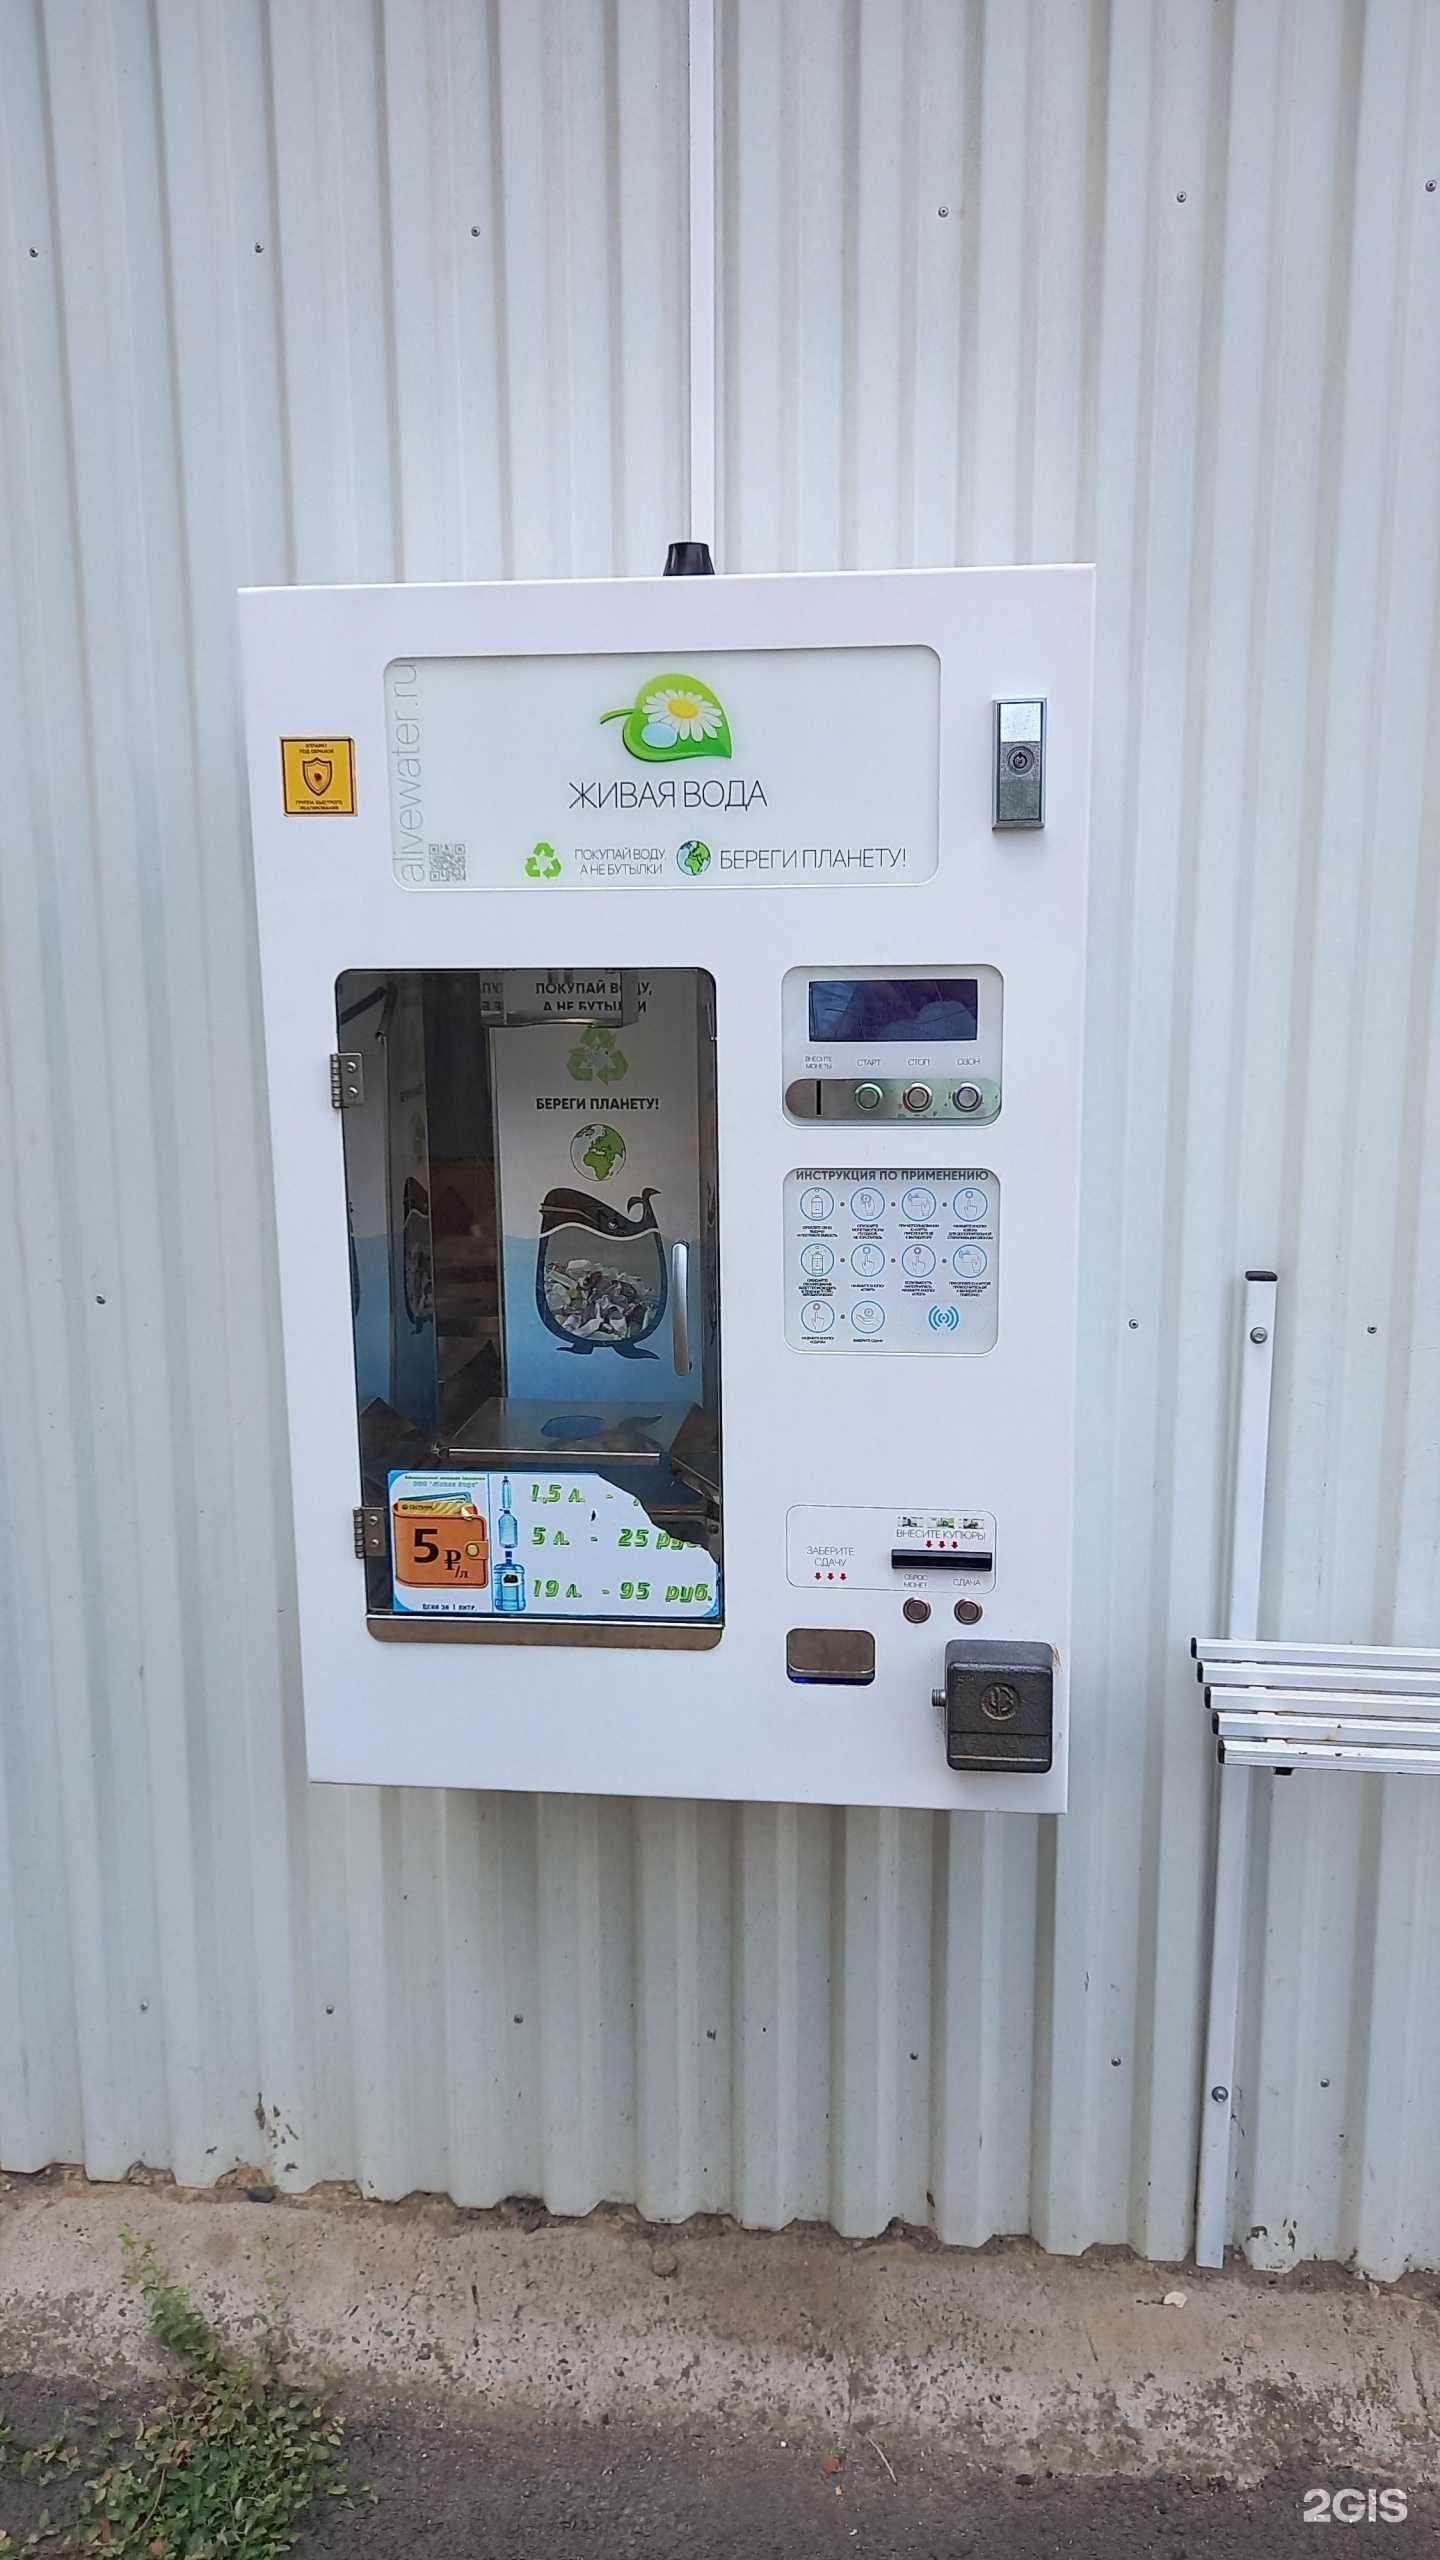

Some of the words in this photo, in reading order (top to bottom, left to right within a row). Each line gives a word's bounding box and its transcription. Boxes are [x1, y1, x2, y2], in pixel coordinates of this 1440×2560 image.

[392, 664, 424, 882] alivewater.ru
[568, 780, 676, 809] ЖИВАЯ
[683, 779, 768, 812] ВОДА
[574, 847, 632, 861] ПОКУПАЙ
[633, 847, 666, 861] ВОДУ
[720, 849, 797, 870] БЕРЕГИ
[802, 848, 906, 869] ПЛАНЕТУ!
[580, 865, 588, 875] А
[590, 864, 606, 876] НЕ
[607, 863, 664, 876] БУТЫЛКИ
[535, 979, 606, 995] ПОКУПАЙ
[857, 1058, 881, 1067] СТАРТ
[907, 1058, 930, 1066] СТОП
[536, 1097, 586, 1110] БЕРЕГИ
[590, 1097, 659, 1110] ПЛАНЕТУ!
[796, 1170, 876, 1182] ИНСТРУКЦИЯ
[879, 1170, 898, 1181] ПО
[901, 1170, 989, 1181] ПРИМЕНЕНИЮ
[530, 1484, 562, 1504] 1,5
[531, 1526, 546, 1546] 5
[618, 1528, 650, 1548] 25
[896, 1529, 940, 1539] ВНЕСИТЕ
[942, 1530, 986, 1541] КУПЮРЫ
[413, 1528, 440, 1564] 5
[806, 1546, 855, 1556] ЗАБЕРИТЕ
[814, 1557, 848, 1567] СДАЧУ
[952, 1578, 981, 1586] СДАЧА
[533, 1579, 560, 1598] 19
[619, 1582, 651, 1600] 95
[665, 1583, 713, 1603] руб.
